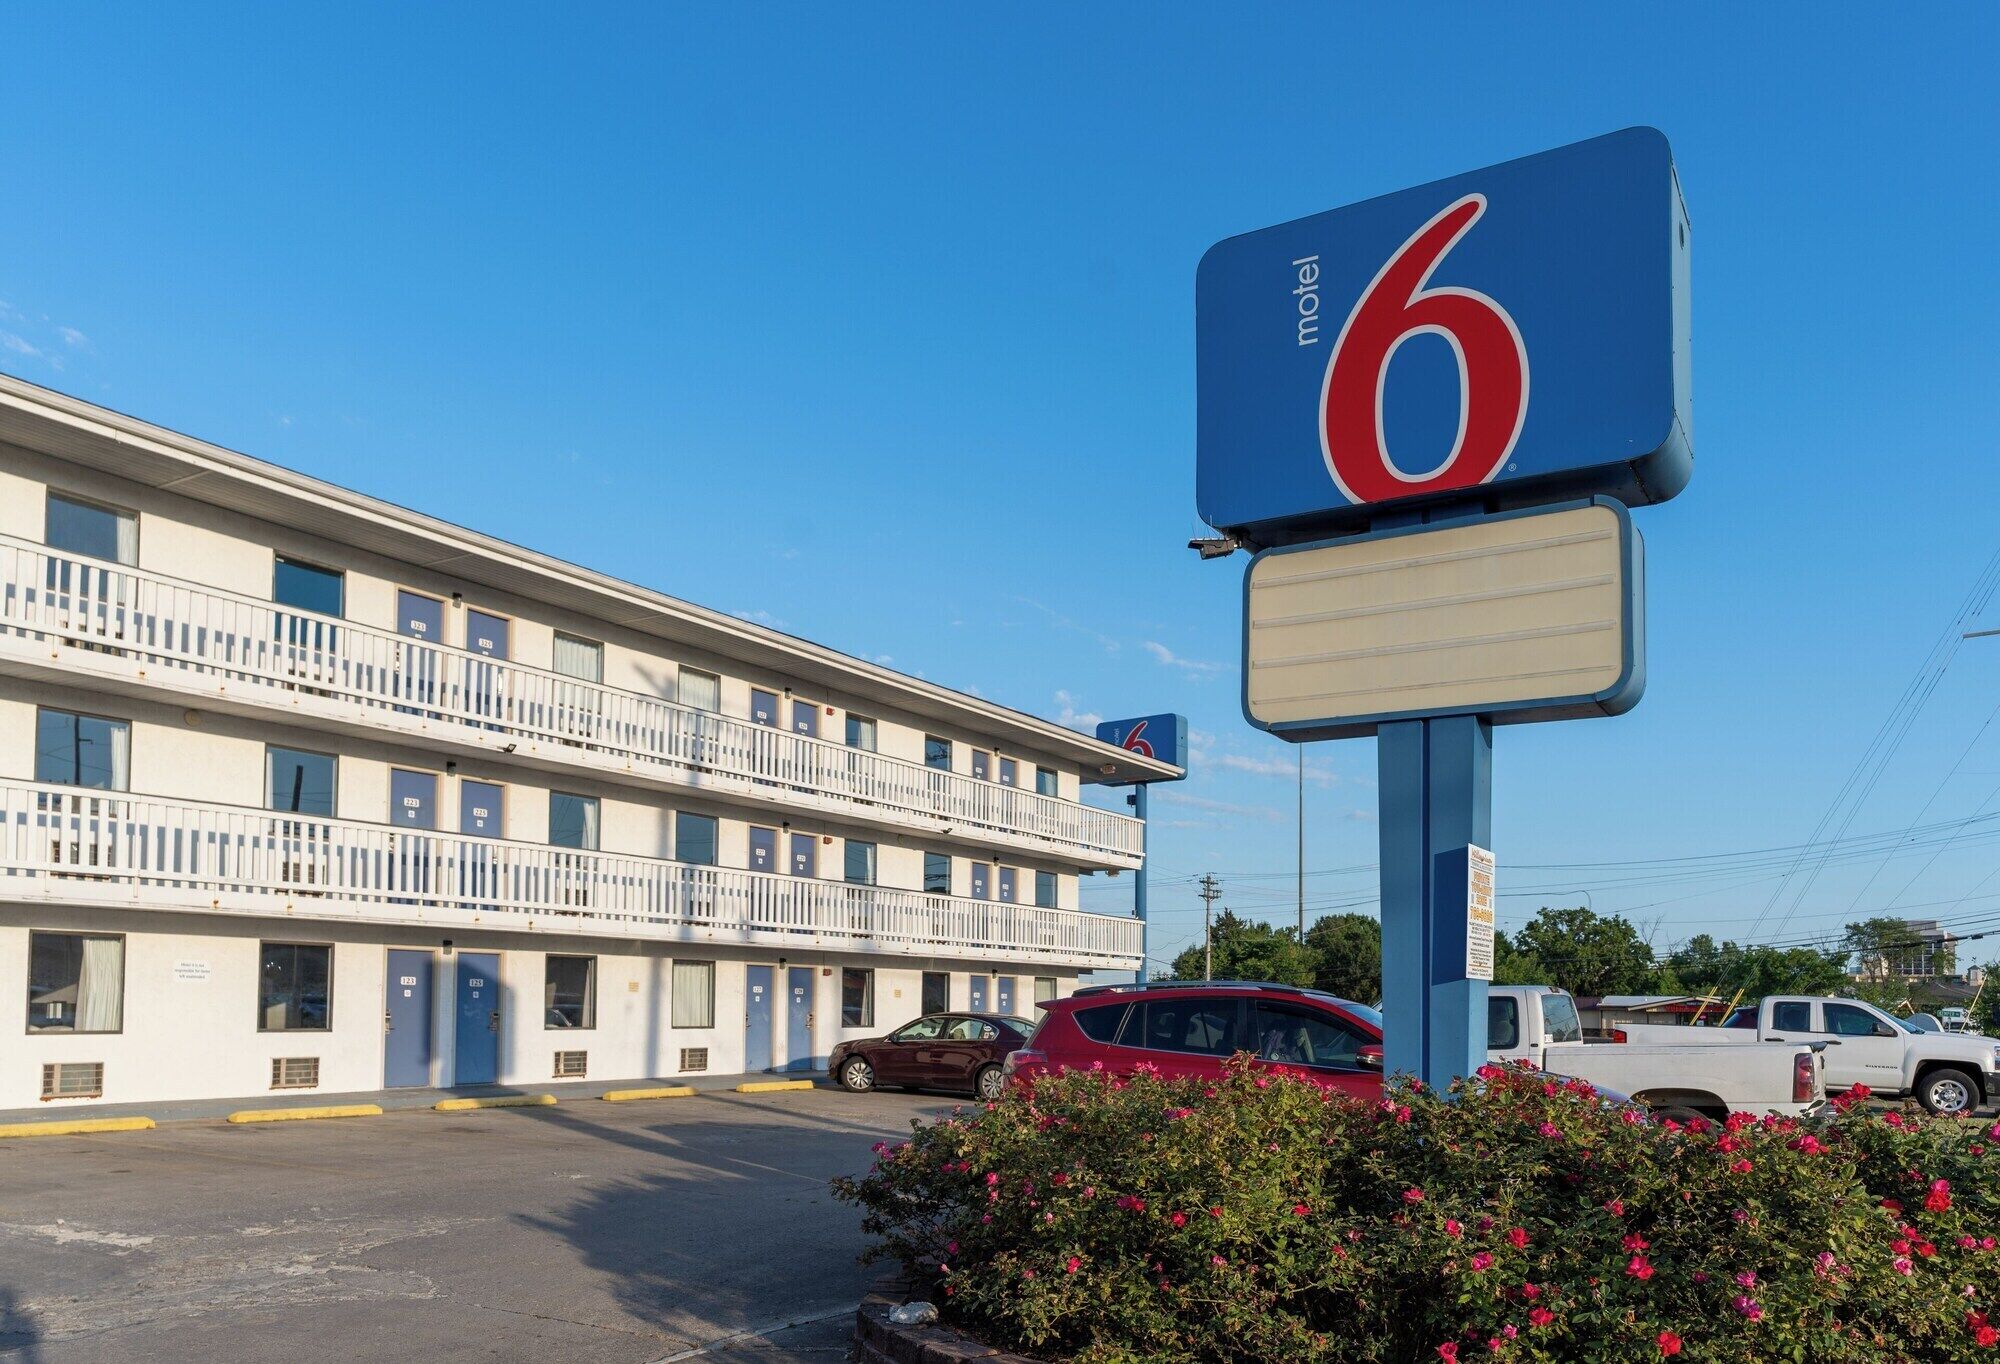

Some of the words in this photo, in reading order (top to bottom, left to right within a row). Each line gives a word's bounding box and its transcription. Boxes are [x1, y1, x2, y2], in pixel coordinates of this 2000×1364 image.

[1292, 255, 1319, 346] motel
[1318, 192, 1530, 505] 6
[412, 621, 425, 631] 323
[480, 639, 492, 648] 325
[1122, 720, 1155, 759] 6
[405, 799, 418, 807] 223
[402, 977, 415, 985] 123
[470, 979, 483, 987] 125
